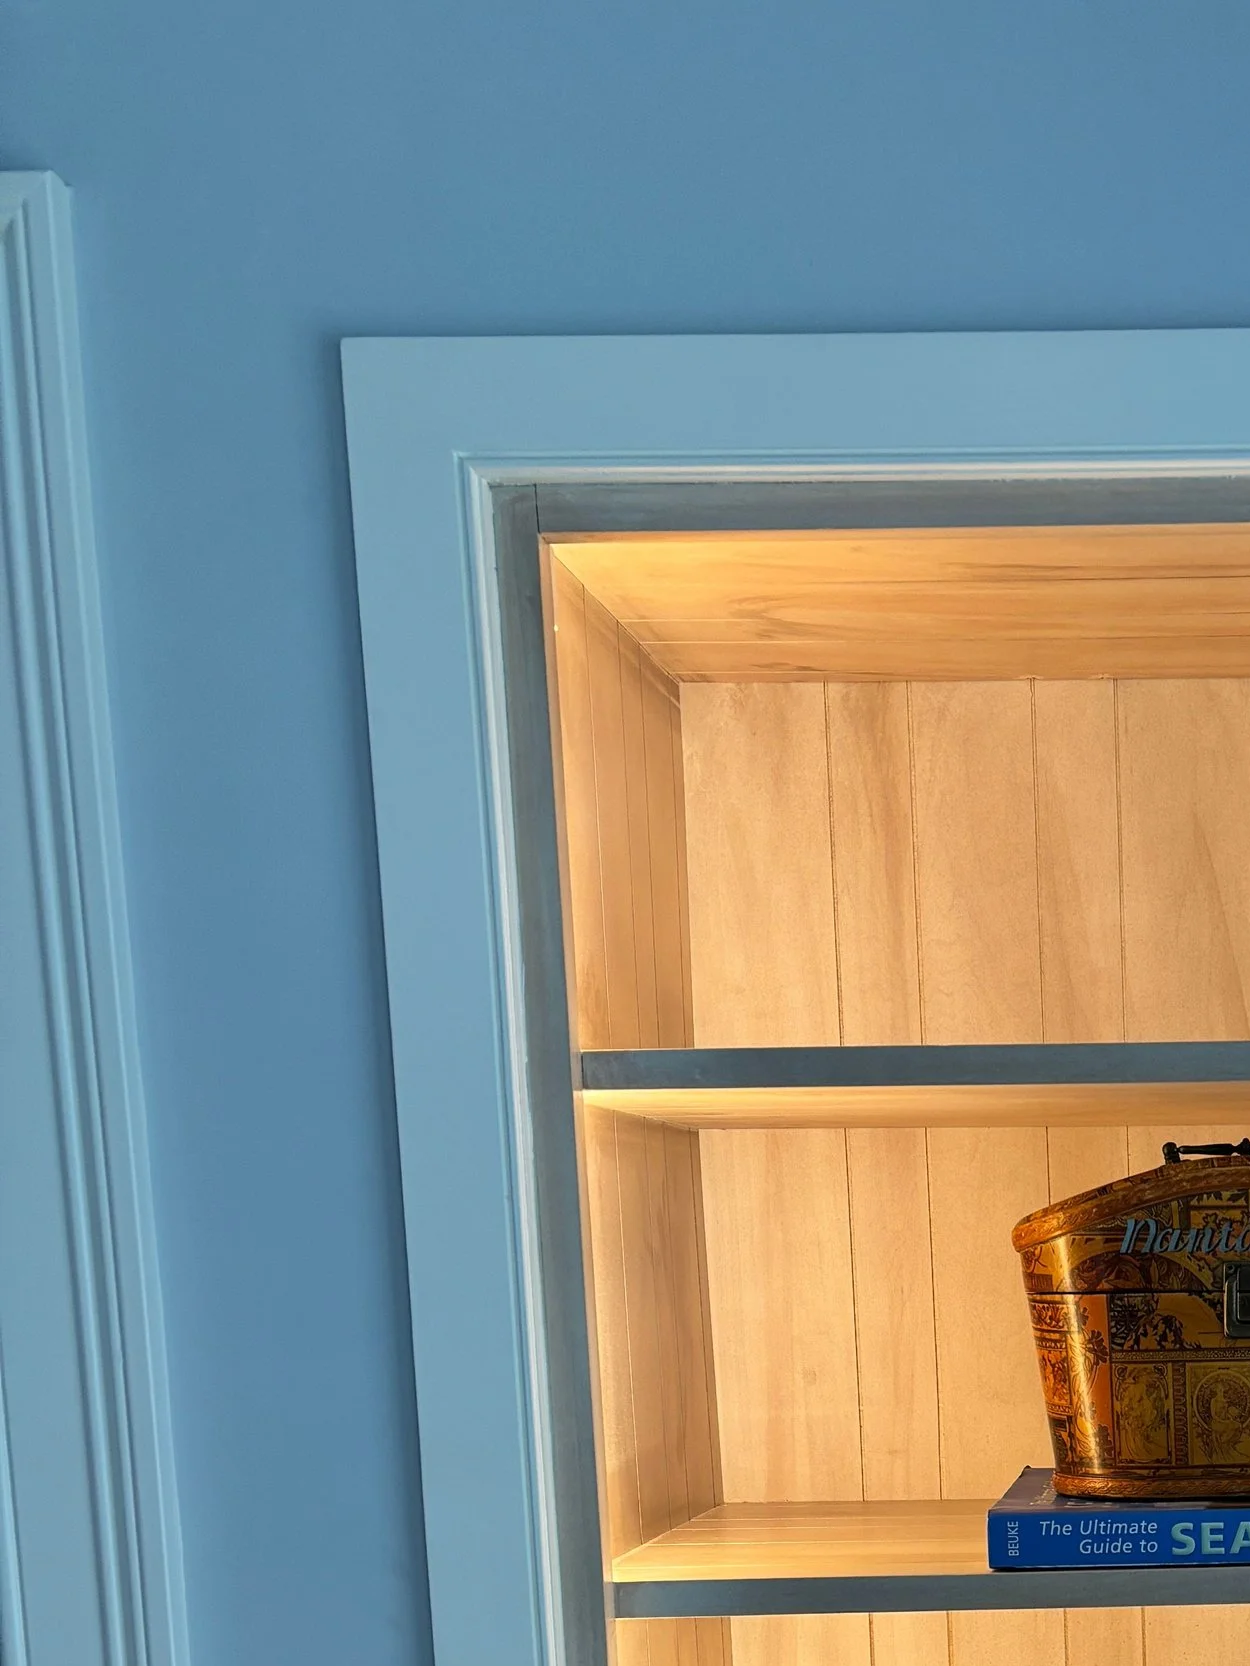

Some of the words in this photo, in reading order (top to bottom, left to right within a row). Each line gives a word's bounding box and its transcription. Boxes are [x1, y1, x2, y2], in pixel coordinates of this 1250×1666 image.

[1039, 1520, 1073, 1536] The
[1079, 1519, 1158, 1535] Ultimate
[1007, 1520, 1020, 1557] BEUKE
[1079, 1538, 1133, 1555] Guide
[1139, 1539, 1159, 1554] to
